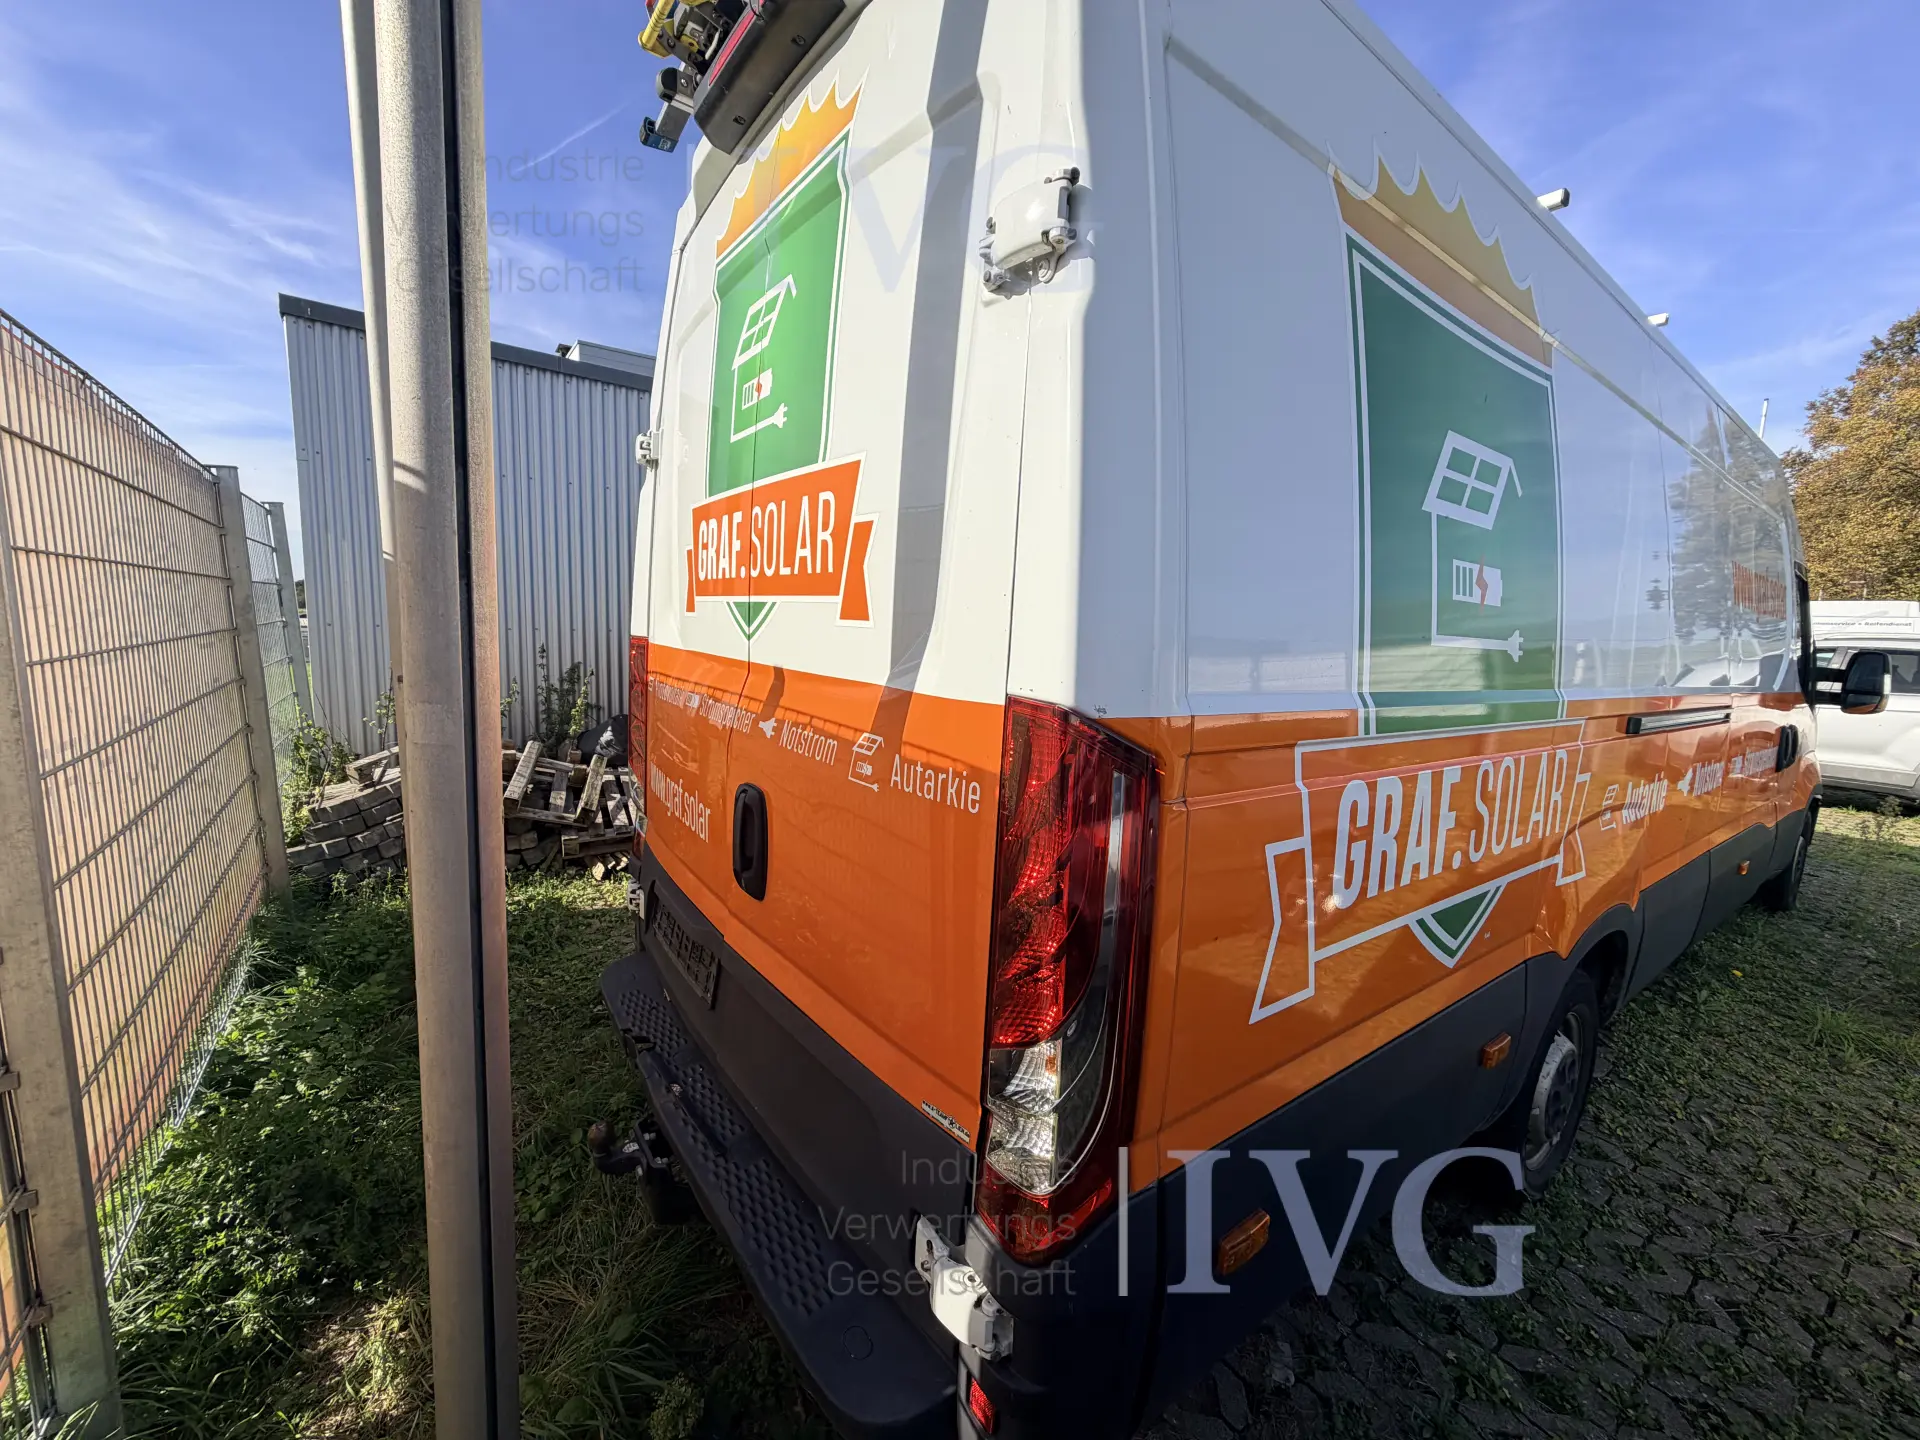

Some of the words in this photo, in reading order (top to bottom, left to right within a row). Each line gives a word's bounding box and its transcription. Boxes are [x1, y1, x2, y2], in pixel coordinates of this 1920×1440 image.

[698, 490, 836, 582] GRAF.SOLAR
[699, 693, 756, 734] Stromspeicher
[779, 719, 838, 766] Notstrom
[890, 754, 981, 814] Autarkie
[1622, 771, 1669, 825] Autarkie
[650, 761, 711, 843] www.graf.solar
[1332, 749, 1568, 910] GRAF.SOLAR
